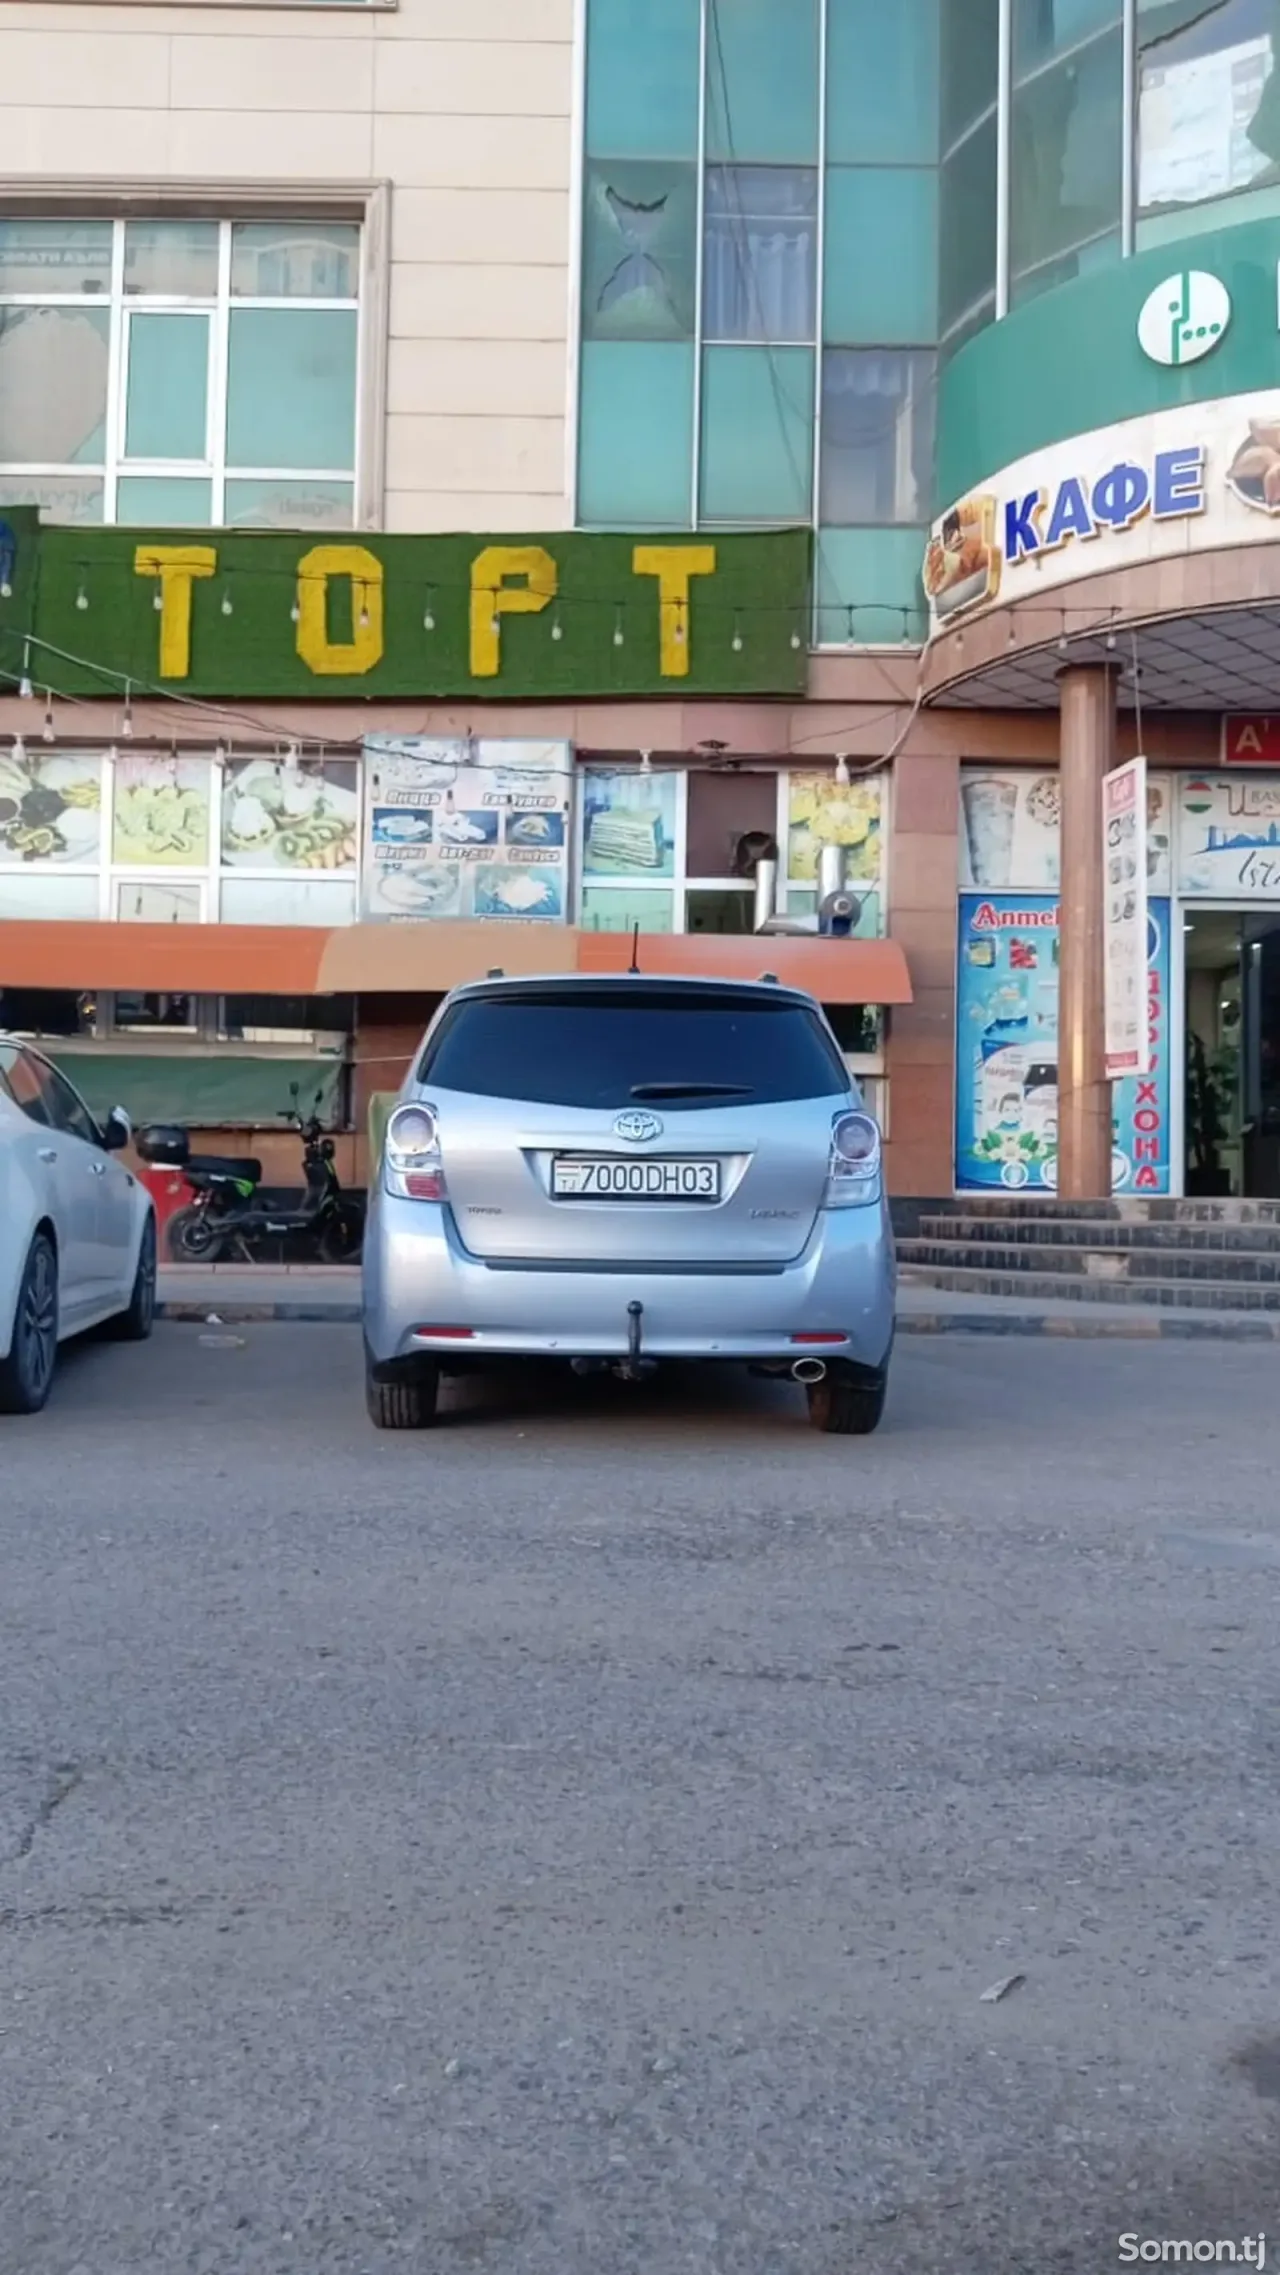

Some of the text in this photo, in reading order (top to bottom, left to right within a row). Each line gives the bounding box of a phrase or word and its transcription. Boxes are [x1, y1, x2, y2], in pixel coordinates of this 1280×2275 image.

[1004, 446, 1204, 564] КАФЕ
[134, 545, 716, 678] ТОРТ
[580, 1165, 713, 1192] 7000DH03
